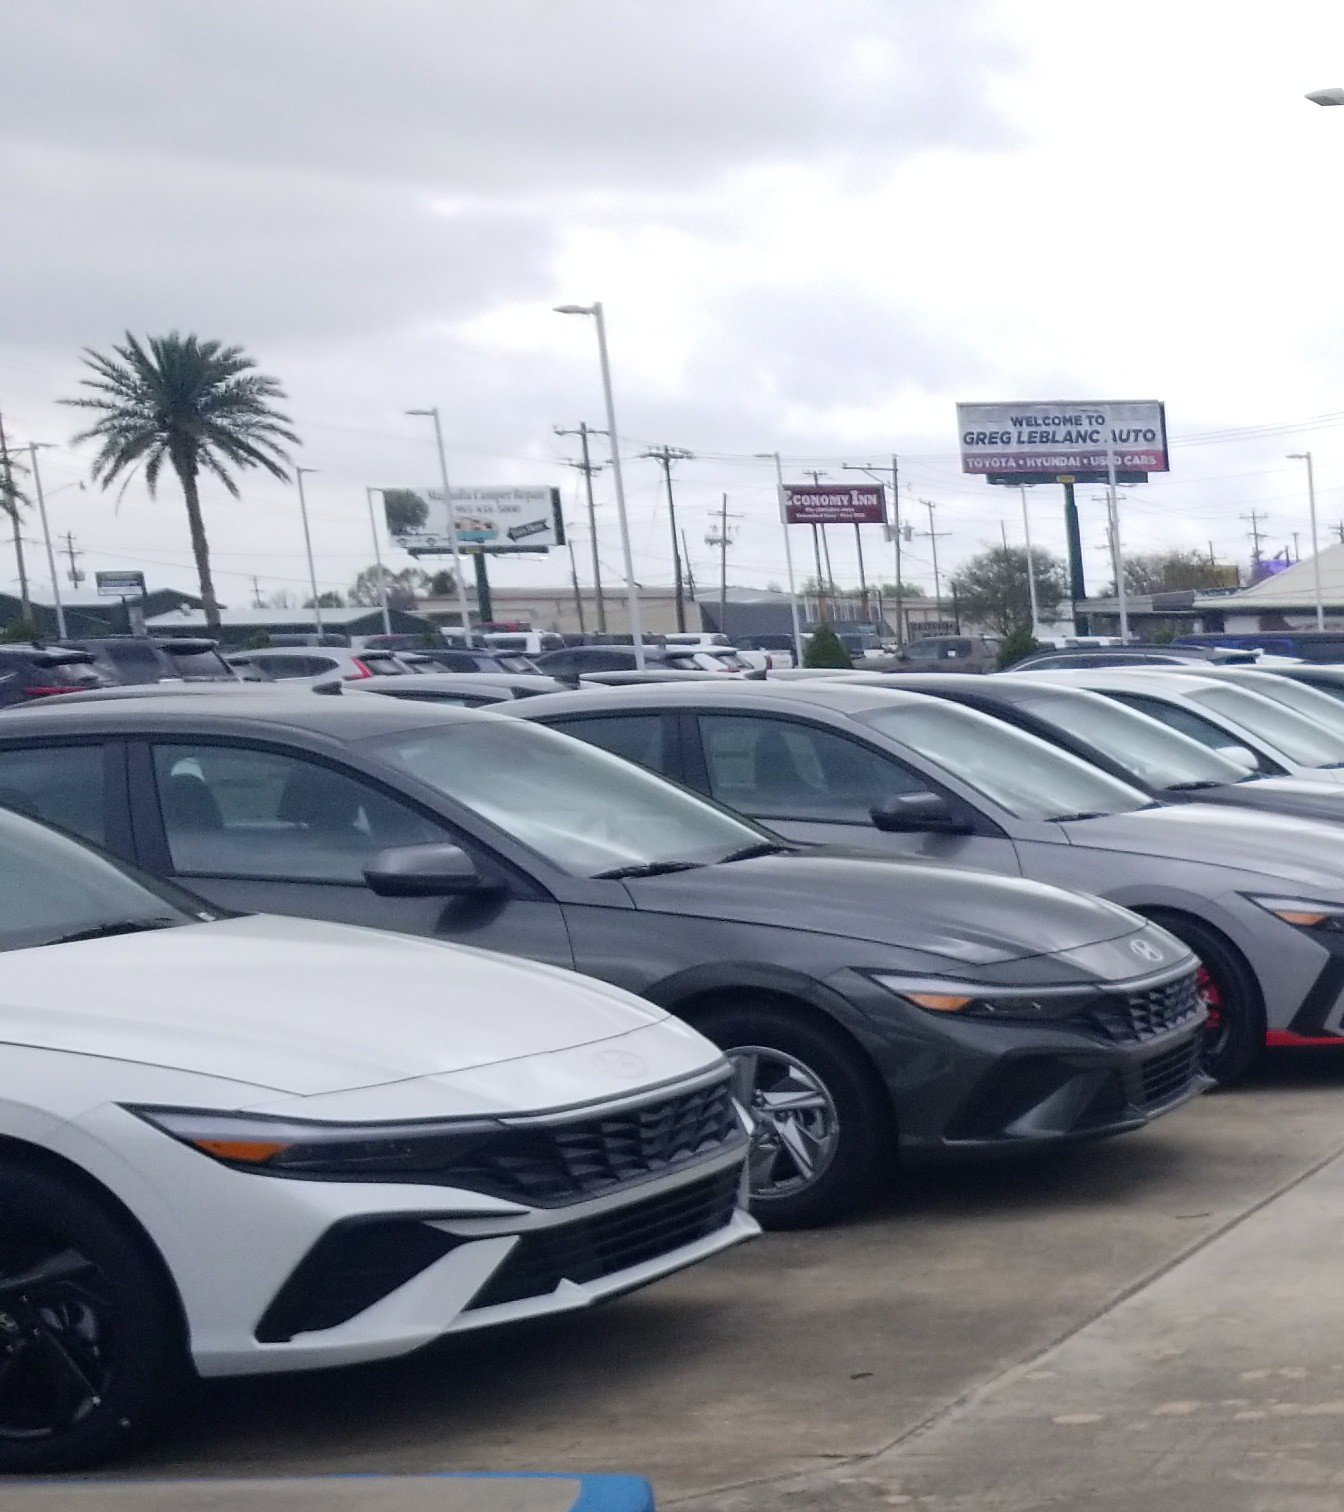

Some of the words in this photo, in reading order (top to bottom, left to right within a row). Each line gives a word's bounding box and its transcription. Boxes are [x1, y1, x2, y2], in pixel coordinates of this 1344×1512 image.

[1010, 415, 1083, 427] WELCOME
[1086, 415, 1106, 426] TO
[962, 431, 1012, 446] GREG
[1016, 429, 1101, 445] LEBLANC
[966, 457, 1017, 468] TOYOTA
[1026, 456, 1081, 467] HYUNDAI
[1089, 455, 1122, 466] USD
[1124, 455, 1157, 466] CARS
[784, 490, 850, 506] ECONOMY
[850, 489, 878, 506] INN
